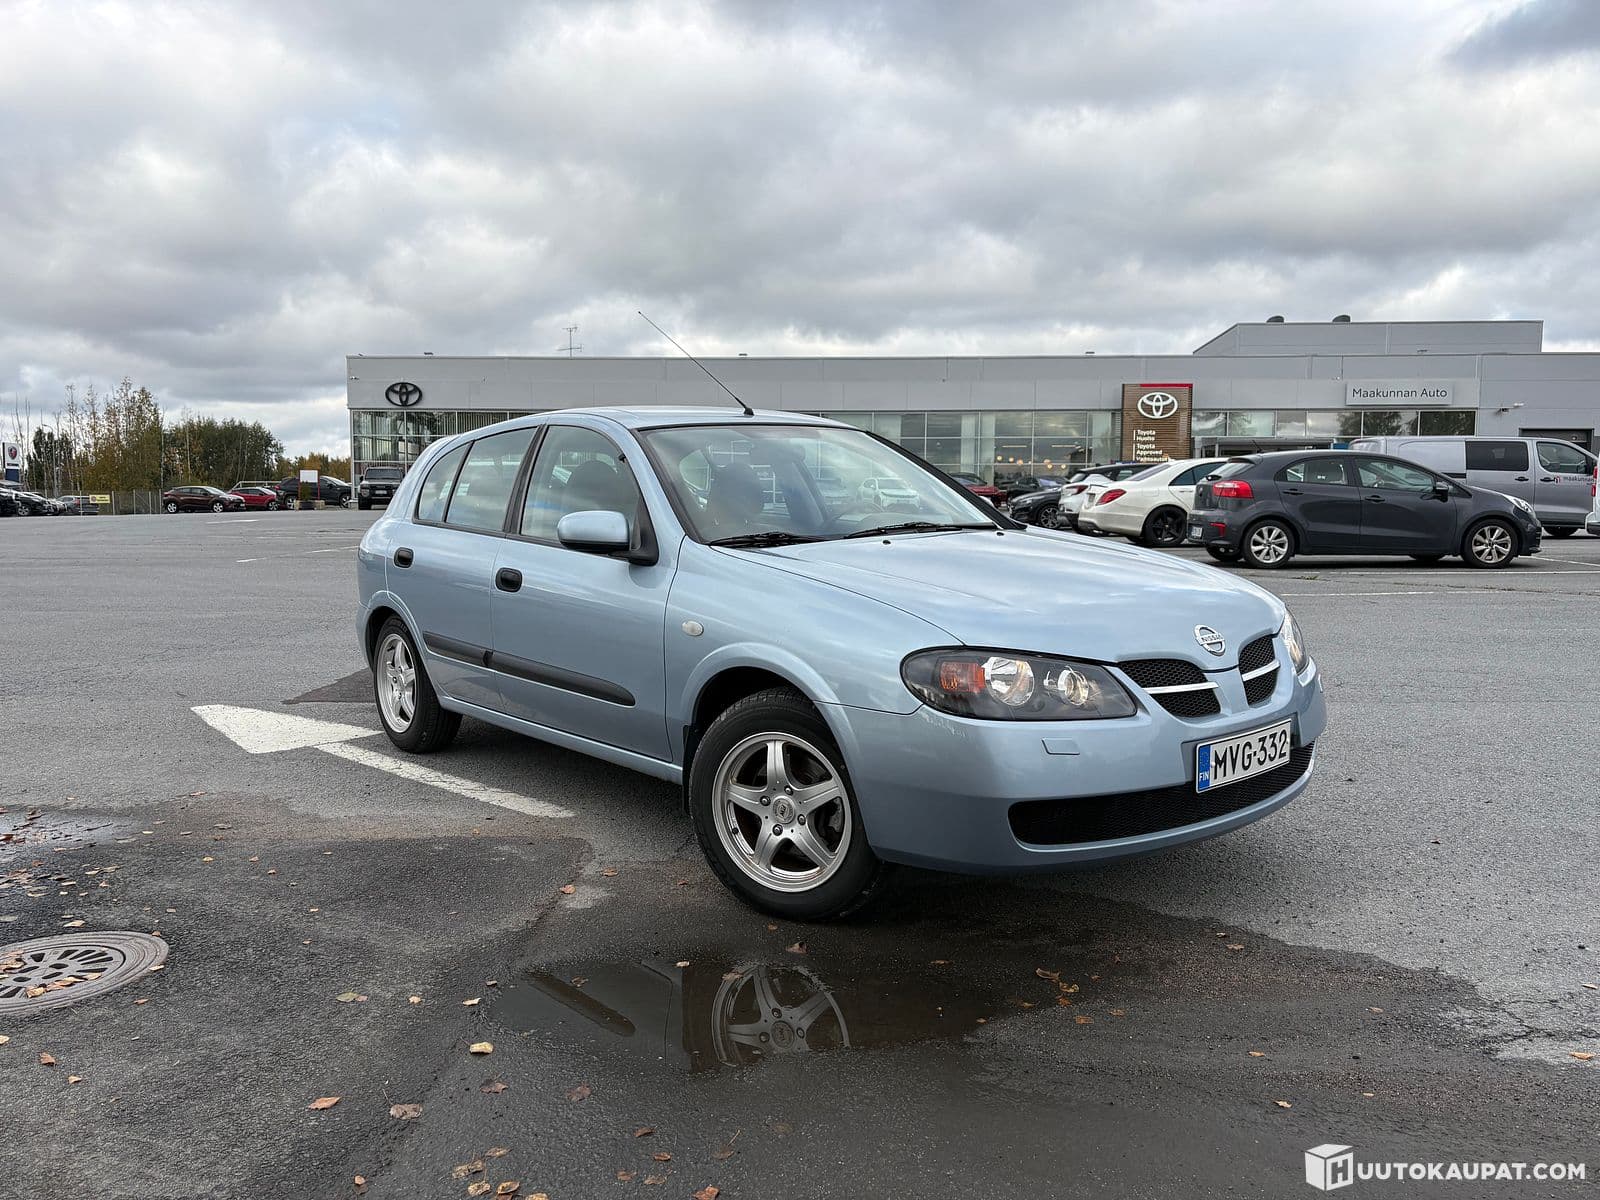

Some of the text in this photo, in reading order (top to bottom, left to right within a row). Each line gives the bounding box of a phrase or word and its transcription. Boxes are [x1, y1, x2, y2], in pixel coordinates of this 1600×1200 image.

[1352, 388, 1448, 398] Maakunnan Auto
[1213, 729, 1288, 780] MVG-332
[1199, 771, 1210, 781] FIN
